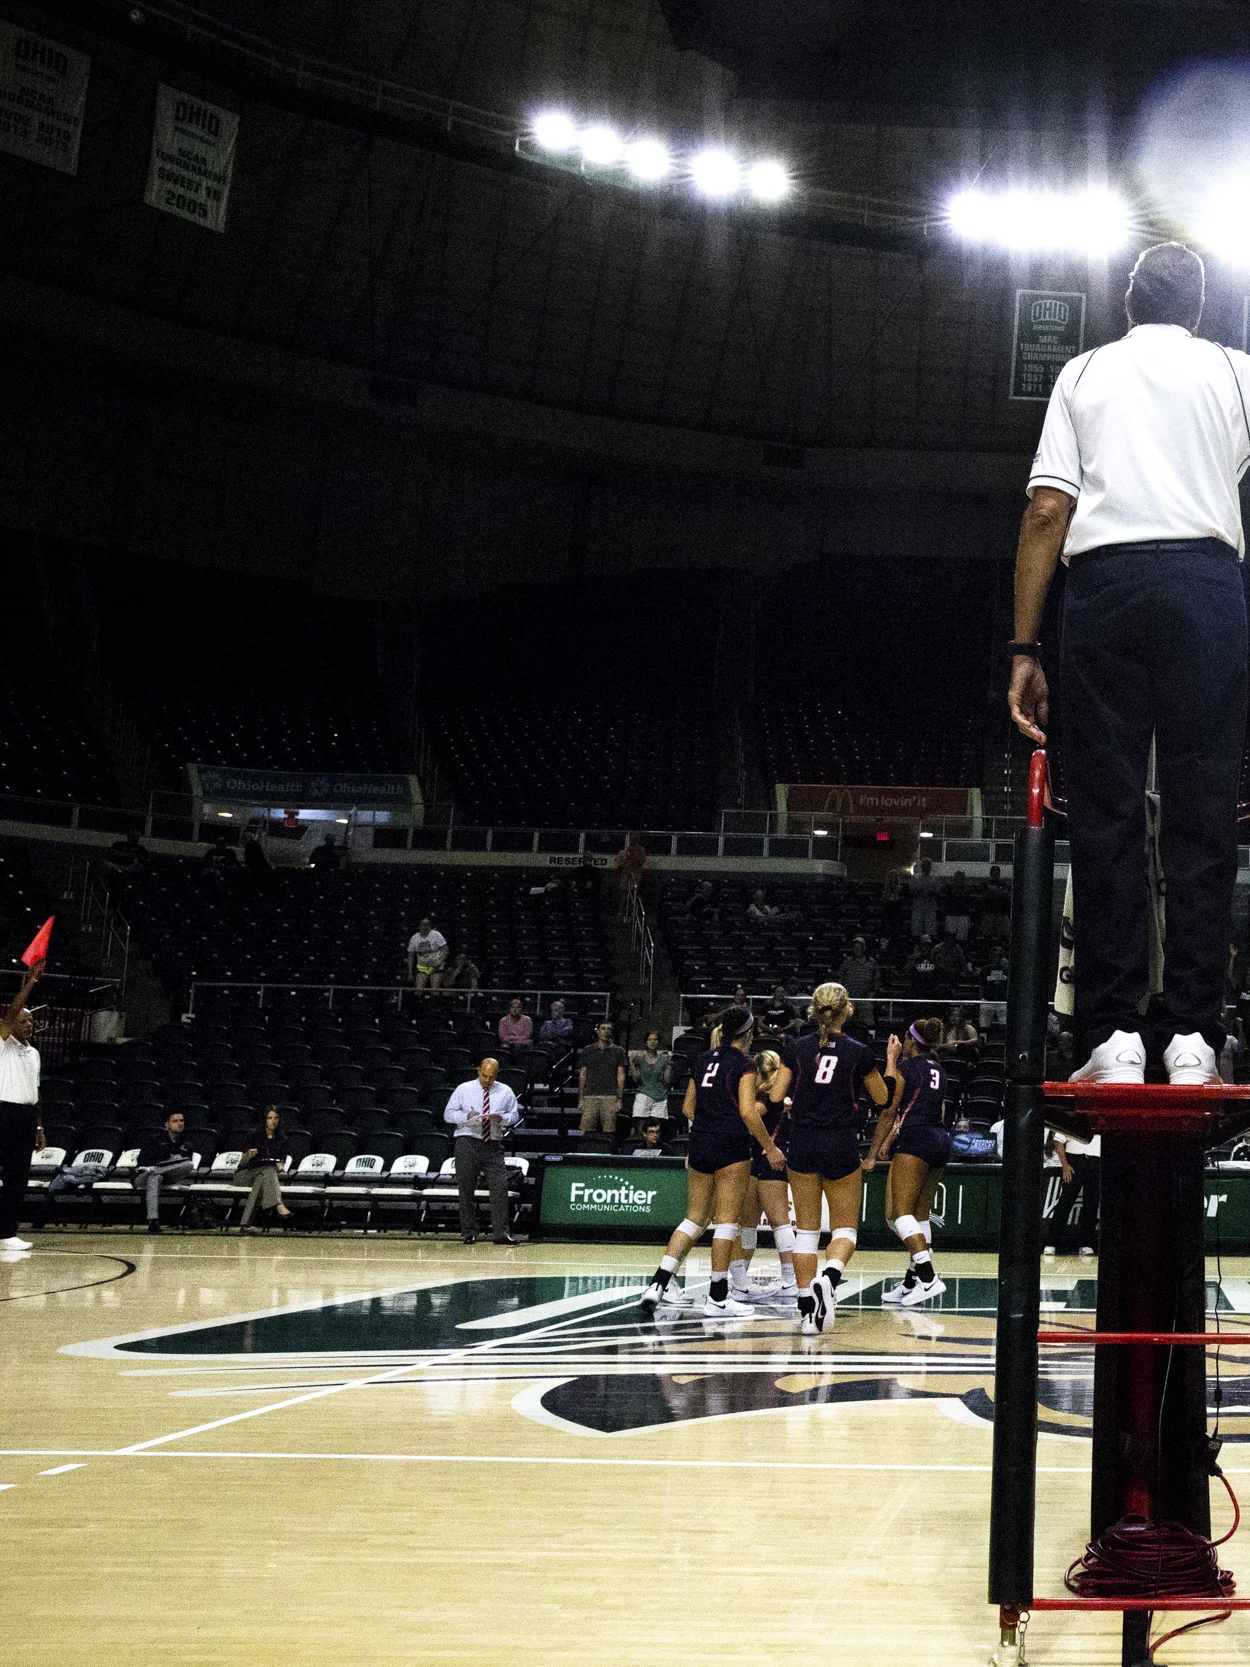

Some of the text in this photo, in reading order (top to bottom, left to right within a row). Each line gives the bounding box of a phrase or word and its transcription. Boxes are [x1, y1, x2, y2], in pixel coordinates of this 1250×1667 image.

[15, 38, 69, 76] OHIO
[0, 89, 80, 128] OURNAMENT
[175, 101, 221, 137] OHIO
[178, 147, 208, 168] NCAA
[158, 167, 203, 195] SWEET
[165, 190, 209, 218] 2005
[1031, 301, 1069, 325] OHIO
[1020, 343, 1077, 354] TOURNAMENT
[1039, 335, 1058, 345] MAC
[226, 779, 404, 796] OhioHealth OhioHealth
[917, 797, 927, 807] it
[549, 856, 608, 867] RESEED
[701, 1062, 719, 1088] 2
[814, 1055, 838, 1085] 8
[929, 1069, 940, 1090] 3
[83, 1151, 106, 1164] OHIO
[356, 1157, 378, 1169] OHIO
[570, 1182, 657, 1204] Frontier
[570, 1203, 652, 1213] COMMUNICATIONS
